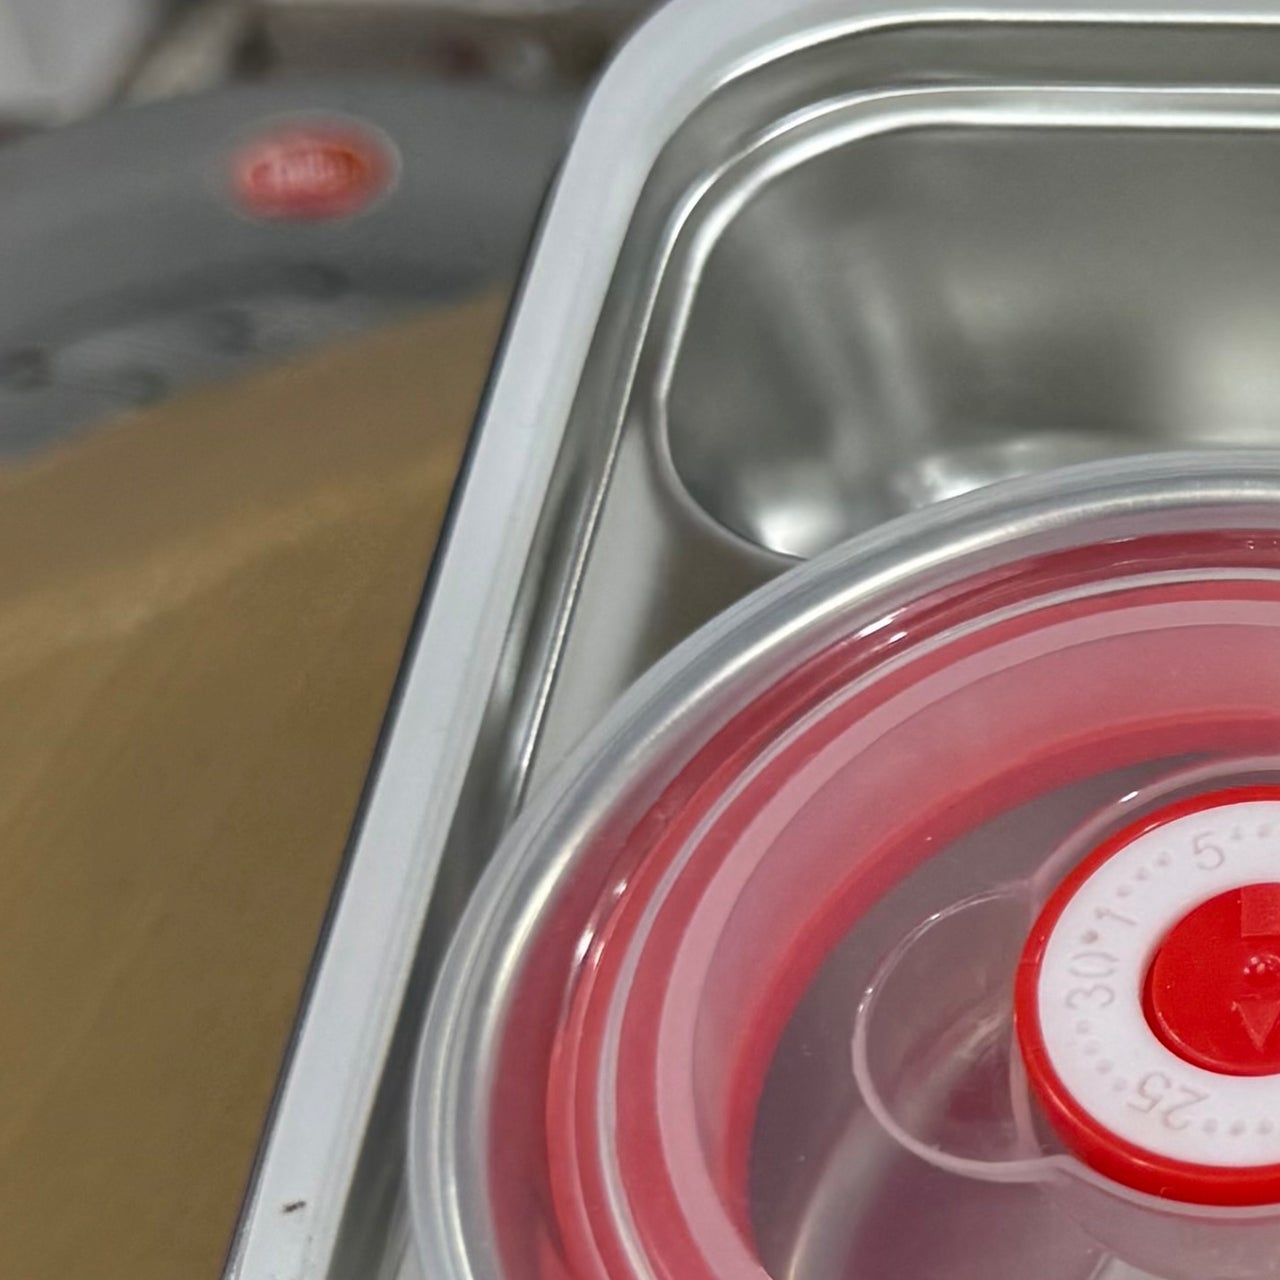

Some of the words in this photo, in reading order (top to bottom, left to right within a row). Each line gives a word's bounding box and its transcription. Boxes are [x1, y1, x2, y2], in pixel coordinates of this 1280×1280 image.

[1191, 829, 1226, 872] 5
[1093, 906, 1138, 927] 1
[1064, 949, 1121, 1010] 30
[1125, 1071, 1212, 1131] 25
